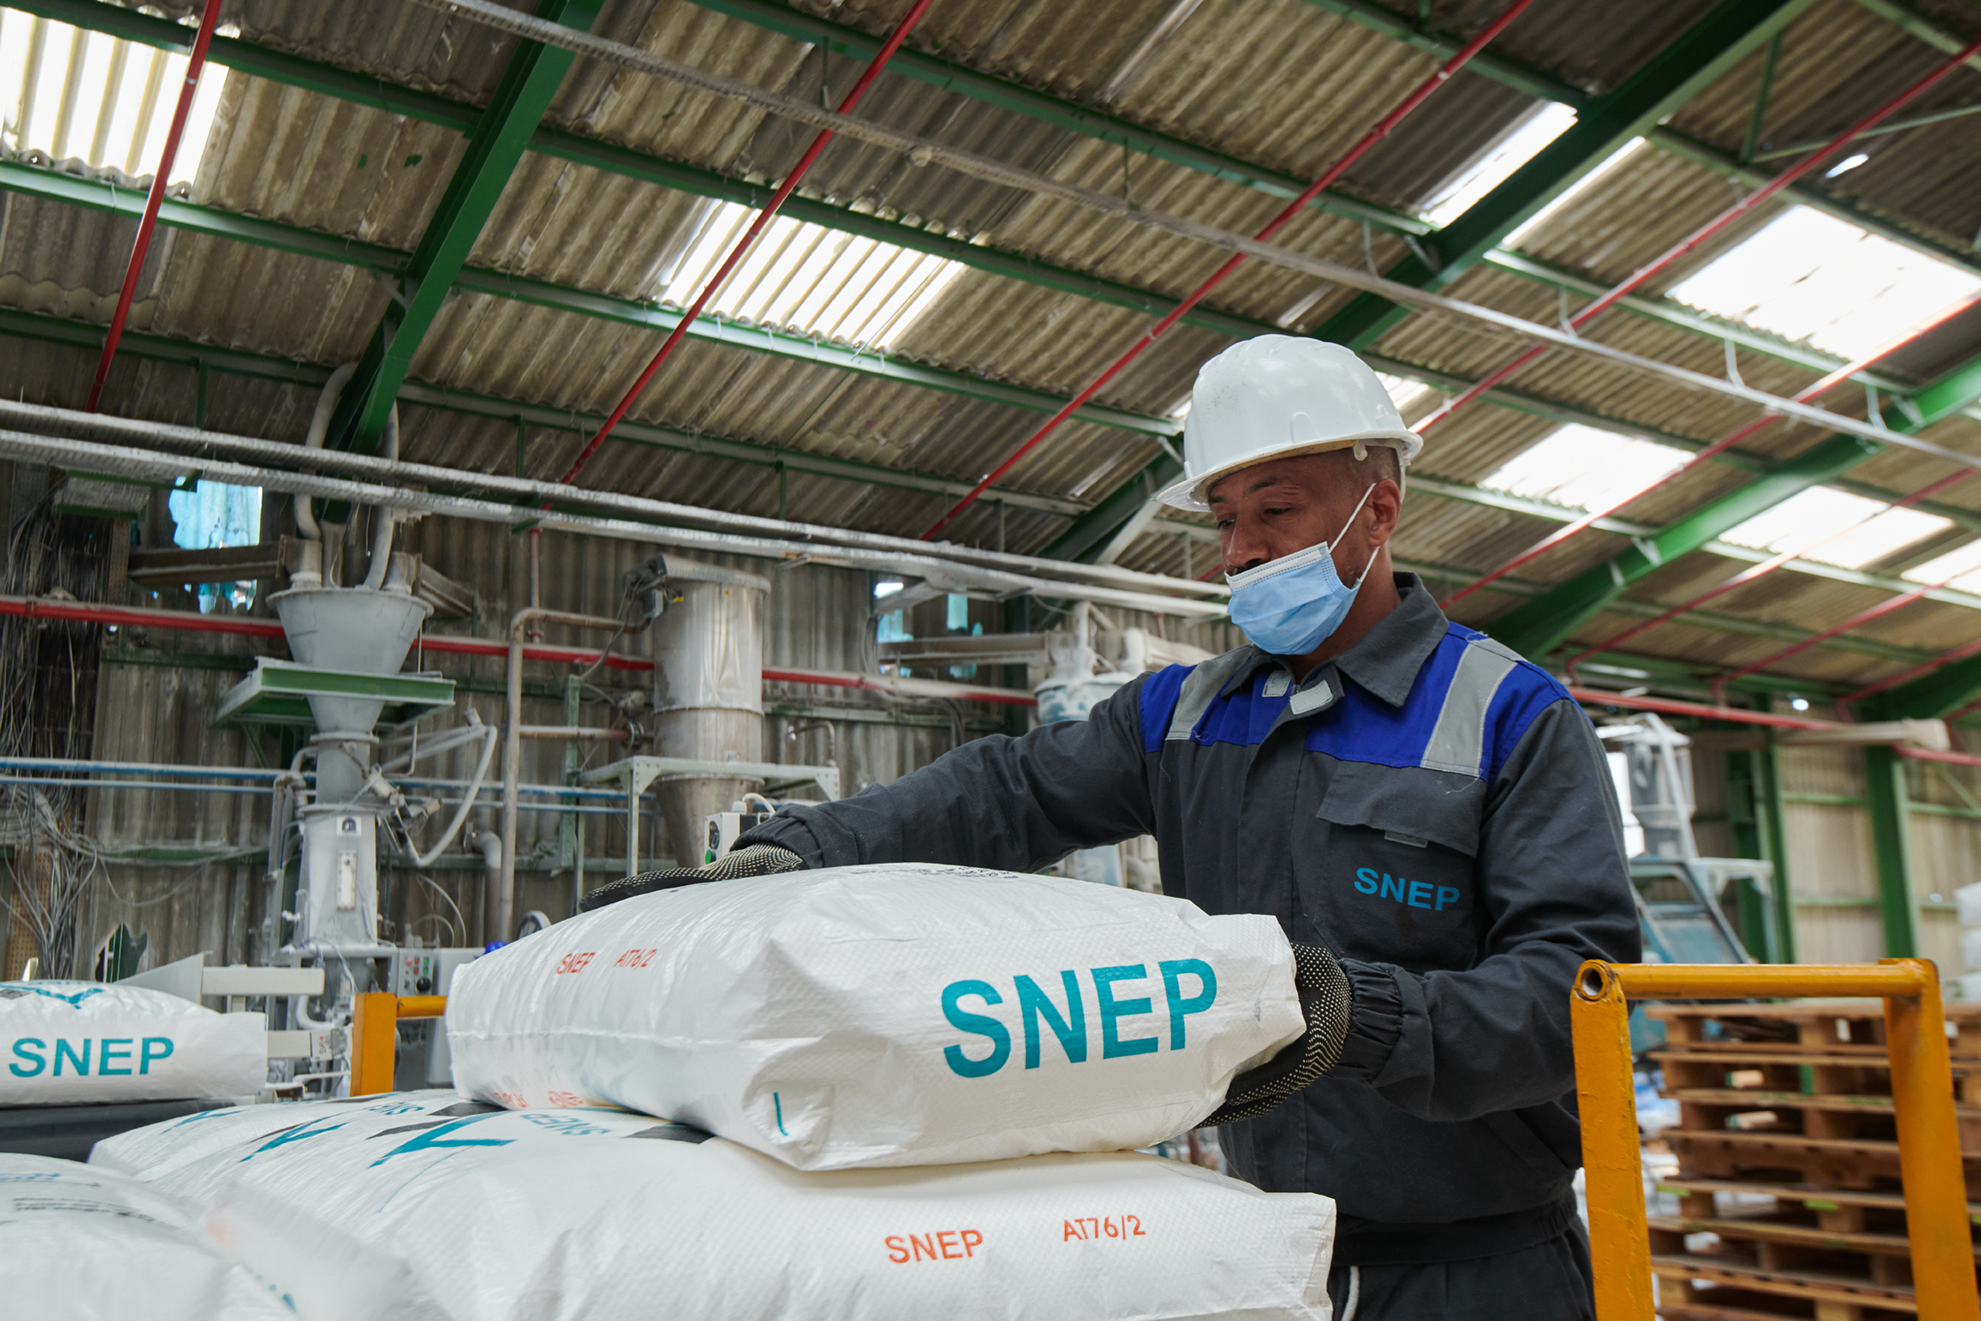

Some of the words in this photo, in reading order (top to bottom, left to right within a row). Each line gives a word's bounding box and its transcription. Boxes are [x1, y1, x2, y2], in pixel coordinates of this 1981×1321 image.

[1353, 867, 1460, 911] SNEP
[555, 951, 597, 975] SNEP
[612, 948, 658, 971] AT76/2
[941, 958, 1218, 1078] SNEP
[8, 1037, 175, 1078] SNEP
[884, 1229, 984, 1264] SNEP
[1063, 1214, 1146, 1242] AT76/2
